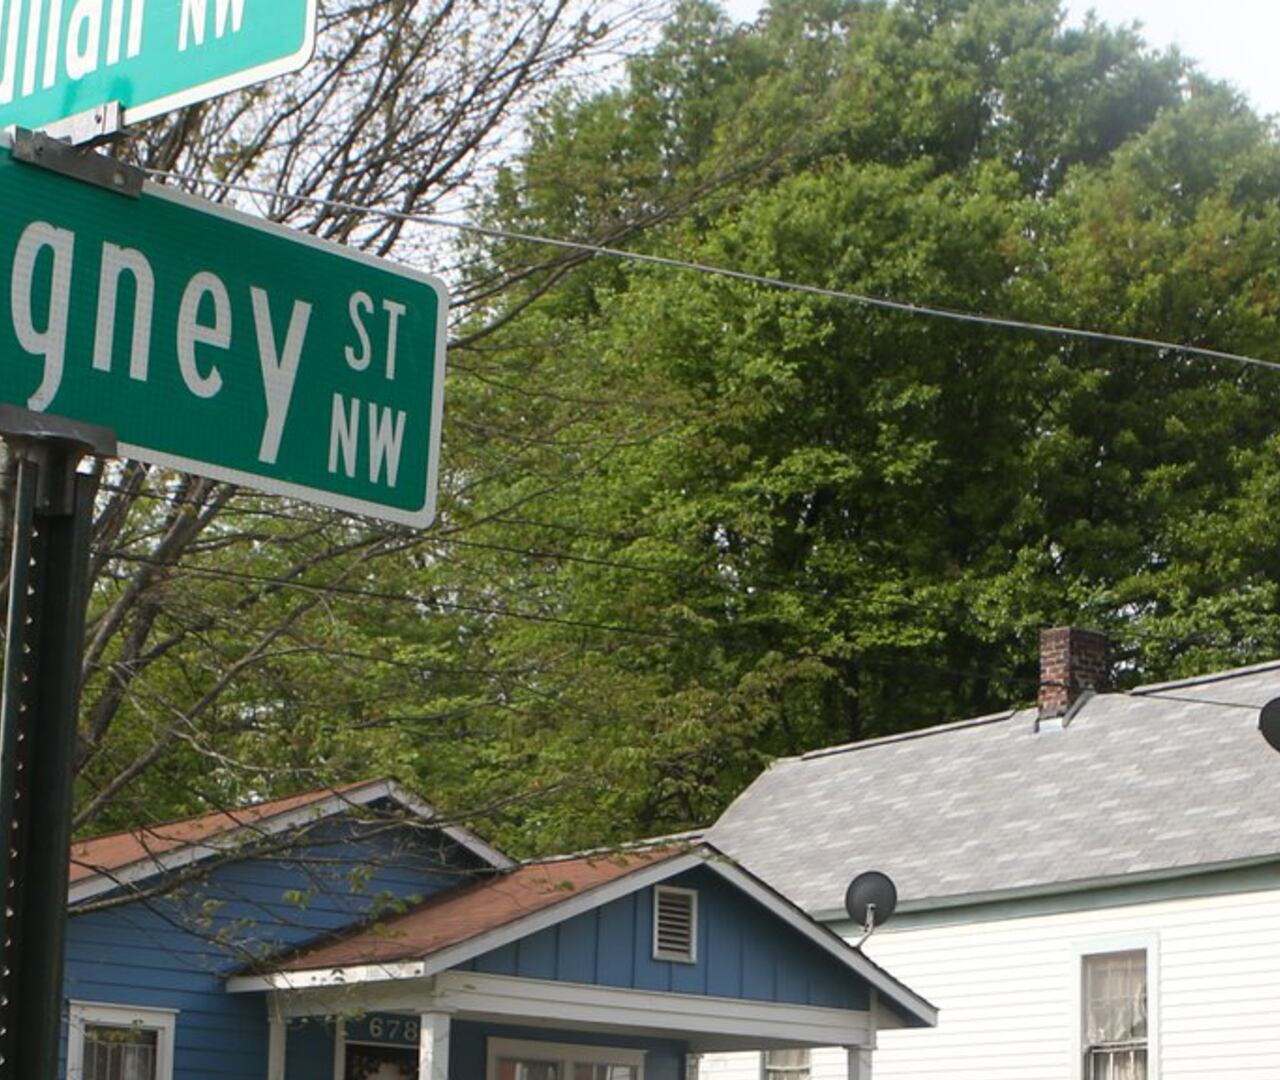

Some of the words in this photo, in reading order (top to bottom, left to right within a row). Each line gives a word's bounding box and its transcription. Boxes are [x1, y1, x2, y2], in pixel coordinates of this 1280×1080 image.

[177, 0, 245, 52] NW
[345, 291, 406, 380] ST
[328, 392, 407, 488] NW
[370, 1018, 418, 1041] 678
